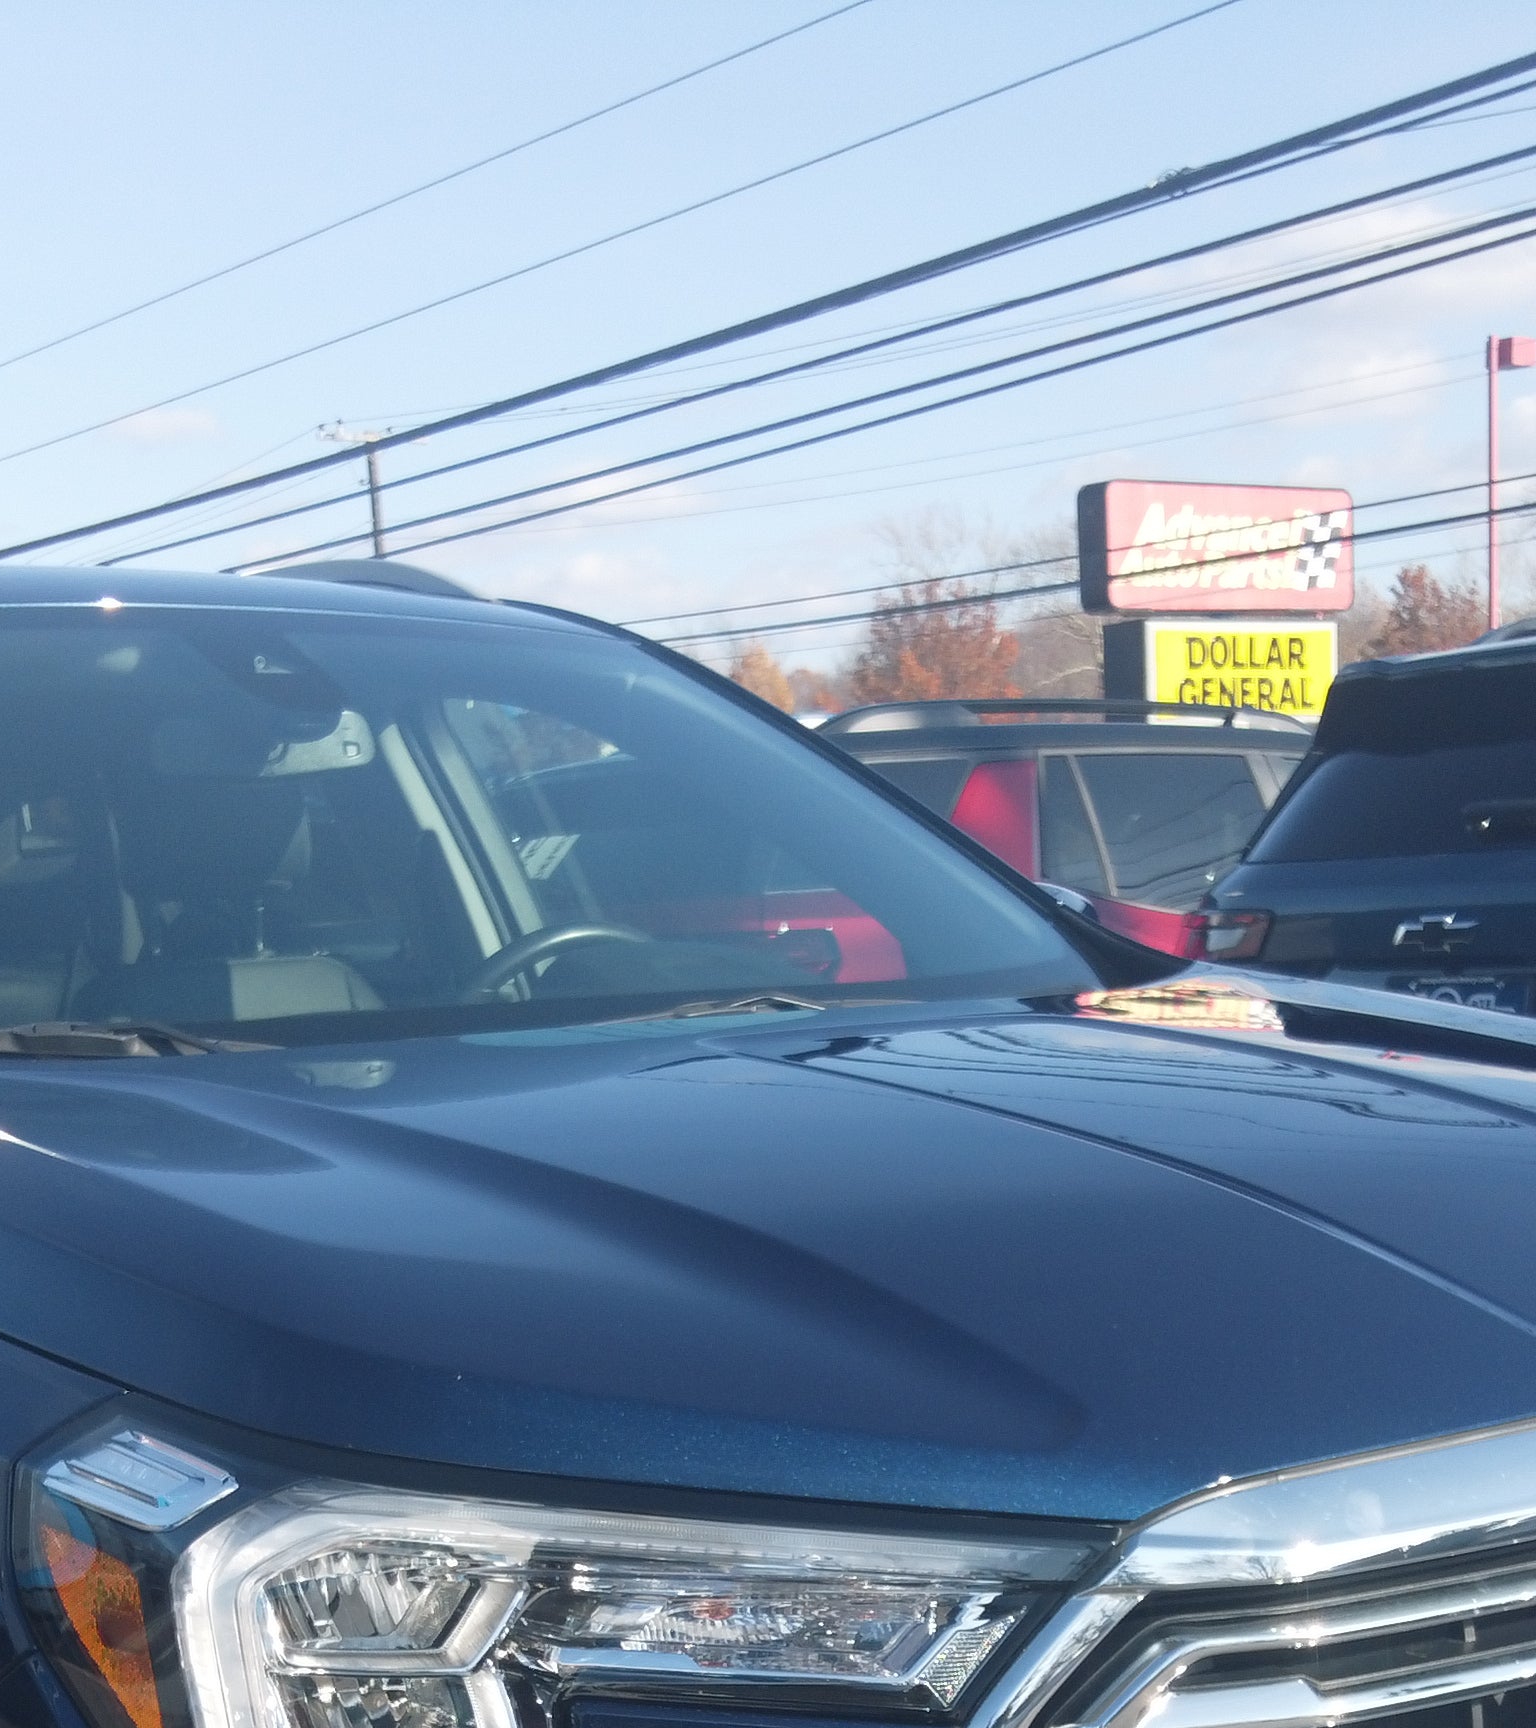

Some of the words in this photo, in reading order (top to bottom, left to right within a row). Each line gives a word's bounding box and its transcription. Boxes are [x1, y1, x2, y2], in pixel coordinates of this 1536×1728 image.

[1133, 503, 1293, 552] Advance
[1118, 550, 1195, 588] Auto
[1199, 551, 1281, 590] Parts
[1186, 635, 1306, 670] DOLLAR
[1179, 677, 1314, 711] GENERAL
